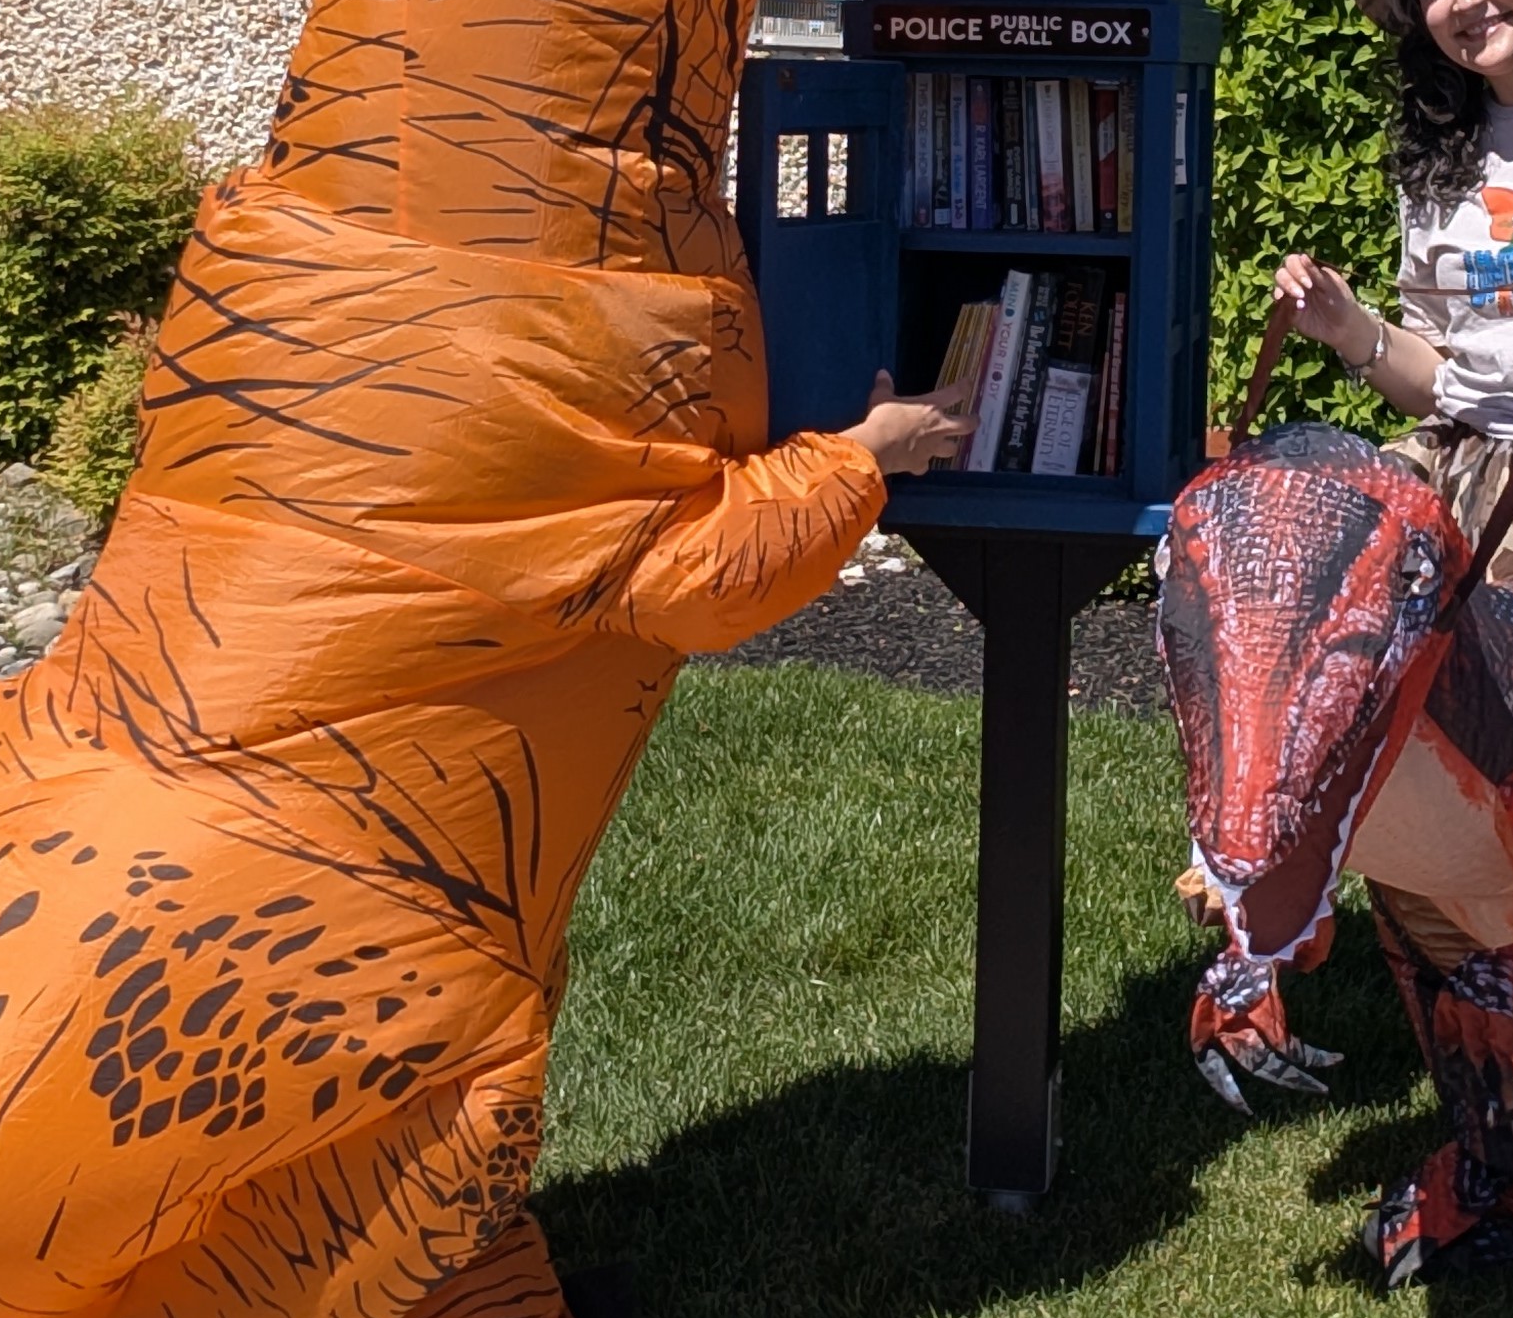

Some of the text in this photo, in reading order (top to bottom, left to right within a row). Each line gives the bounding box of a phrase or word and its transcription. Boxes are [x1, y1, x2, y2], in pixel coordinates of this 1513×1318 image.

[890, 14, 1132, 46] POLICE PUBLIC CALL BOX
[918, 83, 928, 107] THIS
[918, 110, 928, 133] SIDE
[975, 136, 987, 162] KARL
[974, 164, 987, 210] LARGENT
[1077, 301, 1098, 336] KEN
[996, 322, 1013, 358] YOUR
[1021, 339, 1044, 372] Darkest
[988, 363, 1004, 401] BODY
[1018, 372, 1037, 392] Part
[1015, 405, 1030, 420] the
[1017, 393, 1032, 405] of
[1008, 419, 1028, 448] Forest
[1039, 394, 1064, 455] ETERNITY
[1058, 430, 1072, 448] OF
